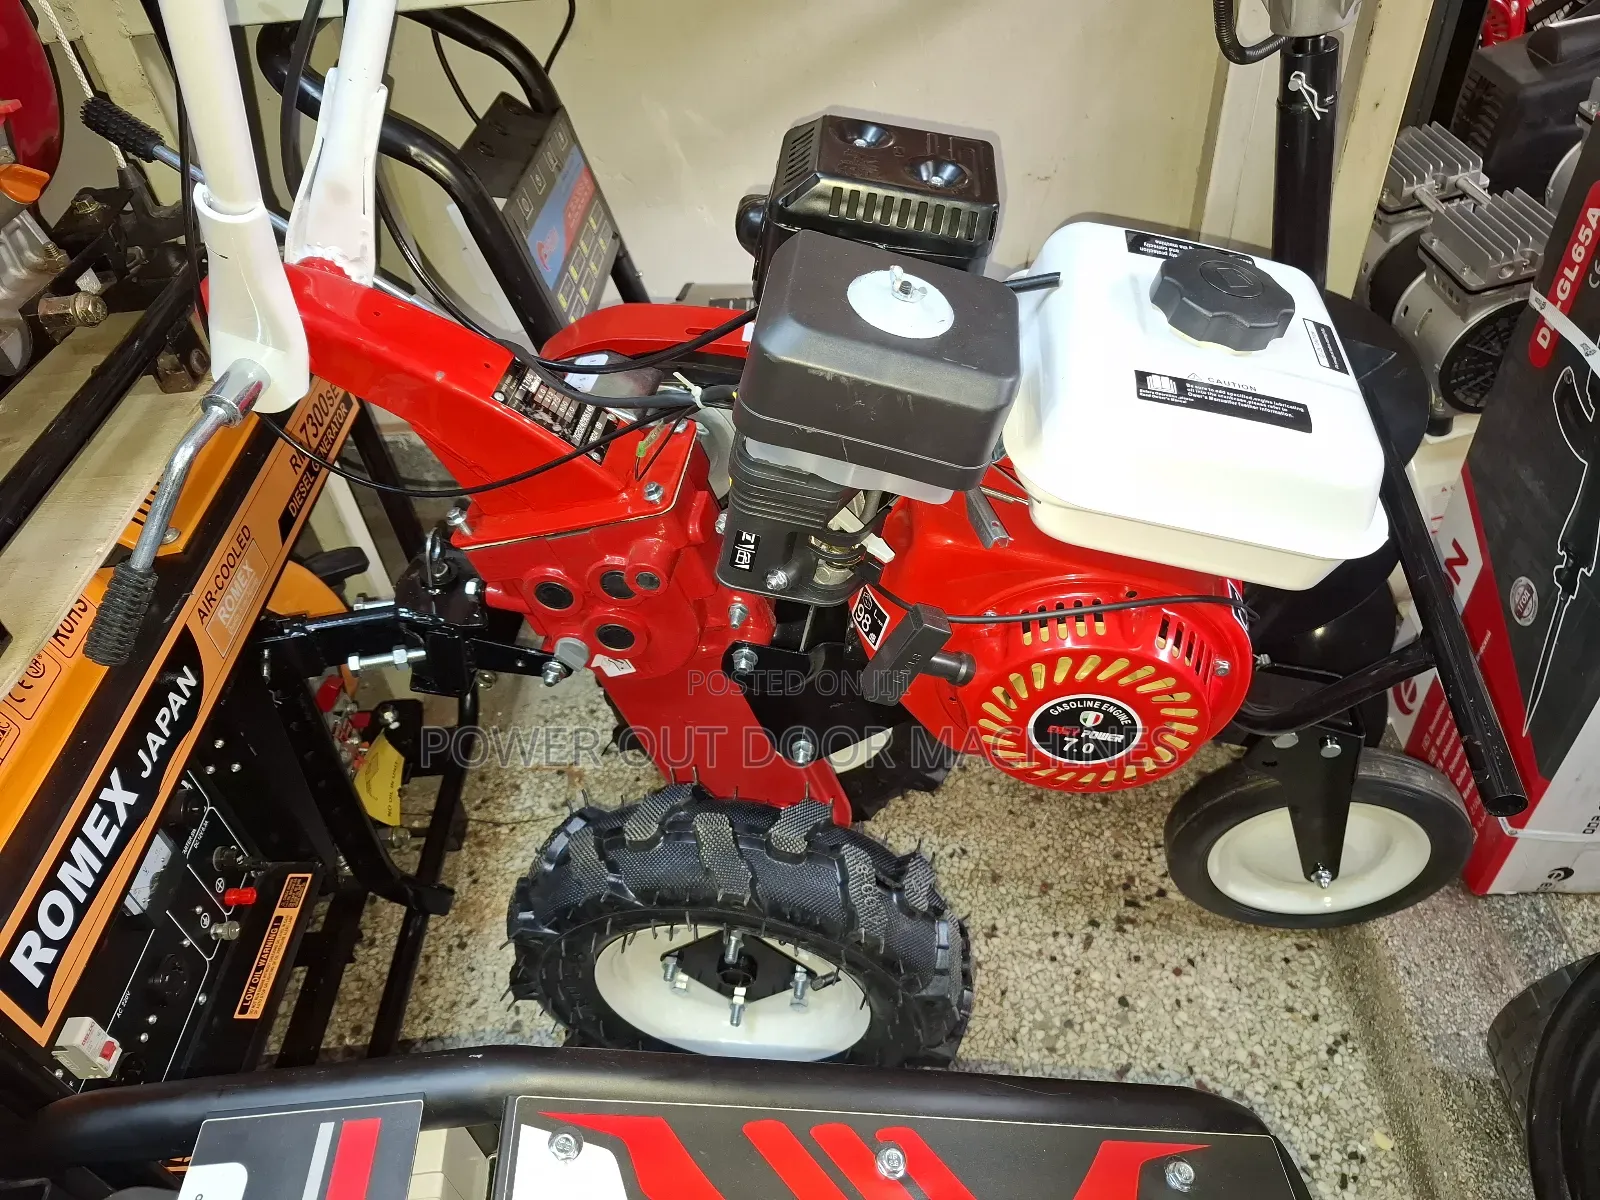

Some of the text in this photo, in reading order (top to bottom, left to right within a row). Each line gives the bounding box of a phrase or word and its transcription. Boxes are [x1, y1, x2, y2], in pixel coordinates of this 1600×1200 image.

[1537, 207, 1600, 349] D-GL65A
[1207, 377, 1257, 392] CAUTION
[287, 403, 349, 518] DIESEL GNERATOR
[197, 524, 252, 626] AIR-COOLED
[217, 558, 257, 626] ROMEX
[854, 603, 873, 632] 98
[1049, 700, 1132, 726] GASOLINE ENGINE
[1081, 729, 1126, 743] POWER
[1062, 737, 1095, 754] 7.0
[10, 665, 198, 989] ROMEX JAPAN
[243, 985, 257, 1006] LOW
[251, 965, 263, 983] OIL
[258, 928, 279, 968] WARNING
[120, 990, 131, 1008] 220V
